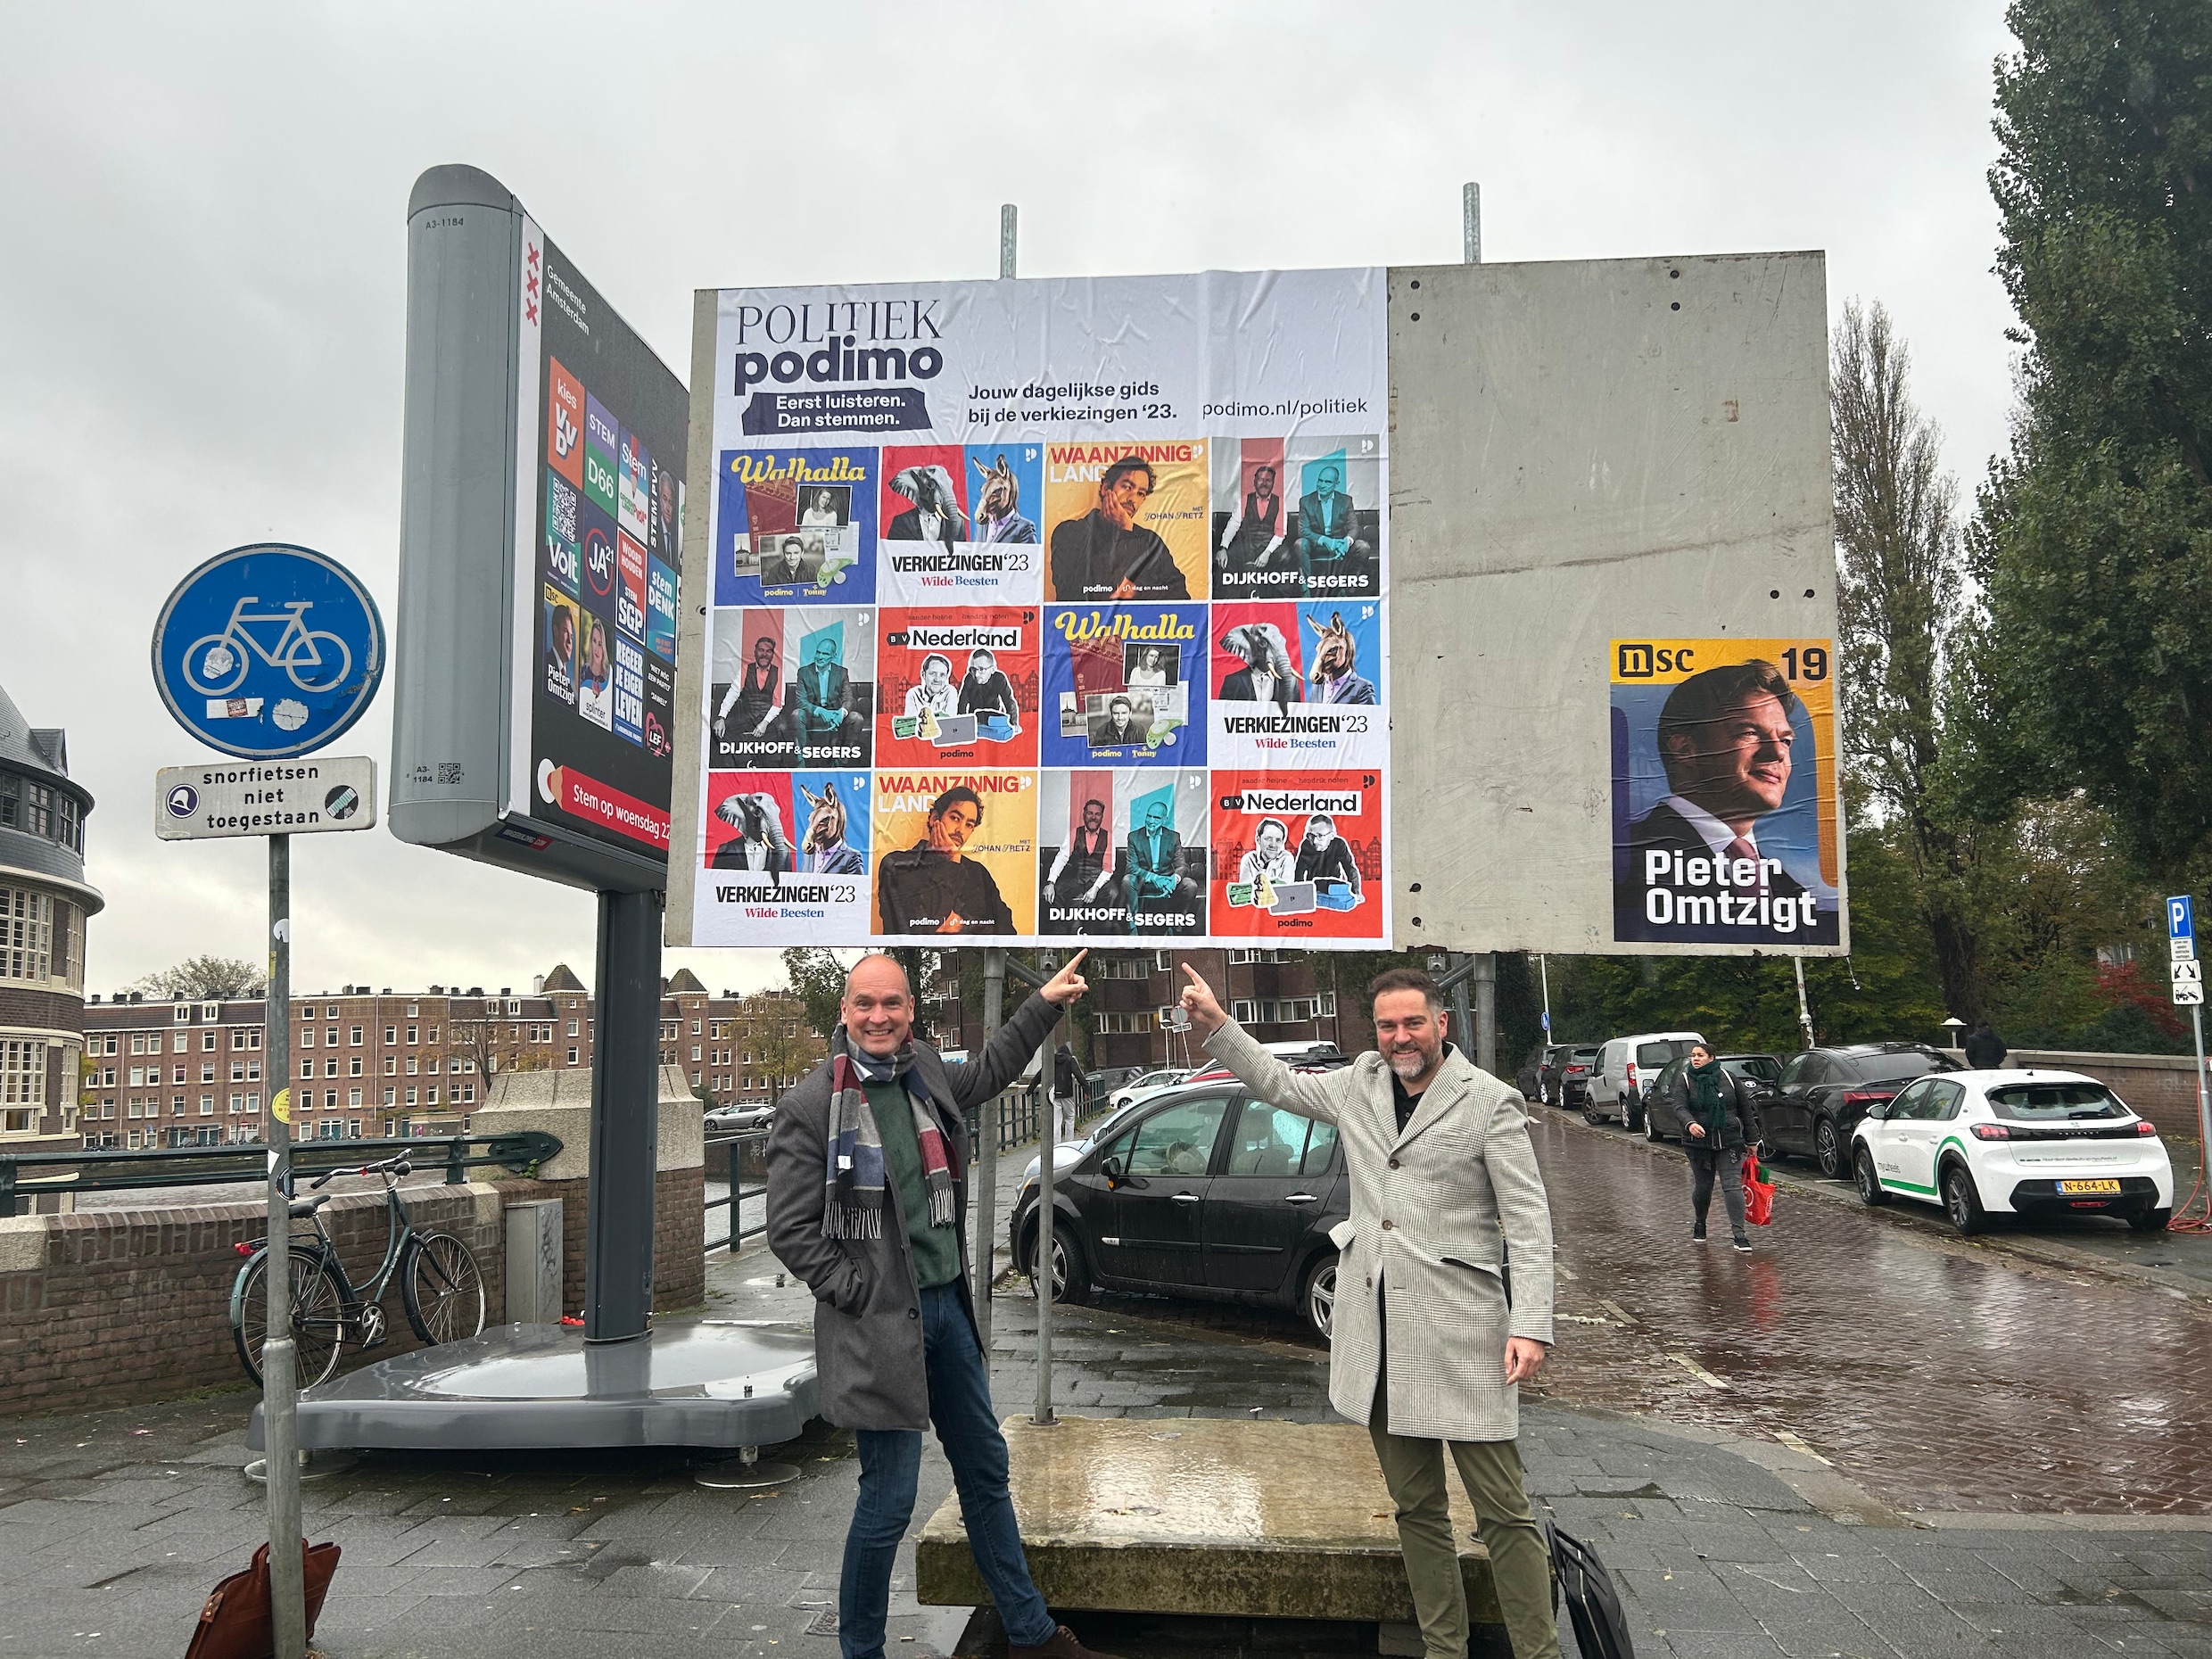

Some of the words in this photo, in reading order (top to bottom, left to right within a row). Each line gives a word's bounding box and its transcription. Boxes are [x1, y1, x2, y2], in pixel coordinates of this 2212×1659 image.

[425, 218, 464, 230] A3-1184
[547, 265, 586, 314] Gemeente
[547, 284, 589, 335] Amsterdam
[735, 300, 944, 345] POLITIEK
[734, 334, 943, 396] podimo
[557, 378, 577, 409] kies
[776, 395, 821, 410] Eerst
[826, 393, 906, 409] luisteren.
[969, 385, 1018, 400] Jouw
[1022, 383, 1115, 401] dagelijkse
[1120, 382, 1159, 400] gids
[969, 409, 989, 426] bij
[995, 408, 1016, 422] de
[1021, 406, 1137, 423] verkiezingen
[1203, 398, 1367, 419] podimo.nl/politiek
[778, 413, 812, 427] Dan
[815, 413, 900, 426] stemmen.
[590, 414, 615, 450] STEM
[622, 442, 647, 481] Stem
[1051, 445, 1191, 464] WAANZINNIG
[589, 457, 614, 499] D66
[730, 455, 866, 483] Walhalla
[549, 535, 578, 583] Volt
[622, 540, 642, 565] WOORD
[621, 554, 642, 580] HOUDEN
[652, 571, 672, 598] stem
[921, 577, 953, 586] Wilde
[955, 576, 998, 586] Beesten
[1083, 584, 1113, 593] podimo
[1222, 572, 1299, 585] DIJKHOFF
[1308, 575, 1369, 588] SEGERS
[648, 584, 675, 621] DENK
[764, 589, 793, 598] podimo
[618, 597, 643, 635] SGP
[1054, 611, 1196, 640] Walhalla
[913, 629, 1017, 647] Nederland
[615, 640, 643, 677] REGEER
[1782, 648, 1827, 680] 19
[548, 664, 570, 687] Pieter
[615, 664, 623, 688] JE
[623, 668, 643, 699] EIGEN
[548, 677, 575, 705] Omtzigt
[615, 688, 642, 729] LEVEN
[649, 730, 662, 746] LEF
[1255, 739, 1288, 748] Wilde
[1291, 739, 1336, 748] Beesten
[719, 742, 795, 754] DIJKHOFF
[803, 747, 862, 758] SEGERS
[940, 750, 974, 759] podimo
[1092, 749, 1122, 758] podimo
[203, 766, 318, 785] snorfietsen
[879, 776, 1019, 793] WAANZINNIG
[244, 789, 284, 805] niet
[1248, 794, 1357, 811] Nederland
[207, 811, 319, 831] toegestaan
[574, 784, 598, 810] Stem
[601, 800, 614, 820] op
[615, 805, 659, 839] woensdag
[1646, 850, 1783, 886] Pieter
[746, 908, 778, 918] Wilde
[780, 908, 824, 918] Beesten
[1050, 908, 1127, 920] DIJKHOFF
[1135, 913, 1196, 926] SEGERS
[1646, 887, 1817, 933] Omtzigt
[2172, 902, 2184, 934] P
[910, 918, 939, 927] podimo
[1278, 919, 1313, 929] podimo
[2064, 1182, 2117, 1192] N-664-LK
